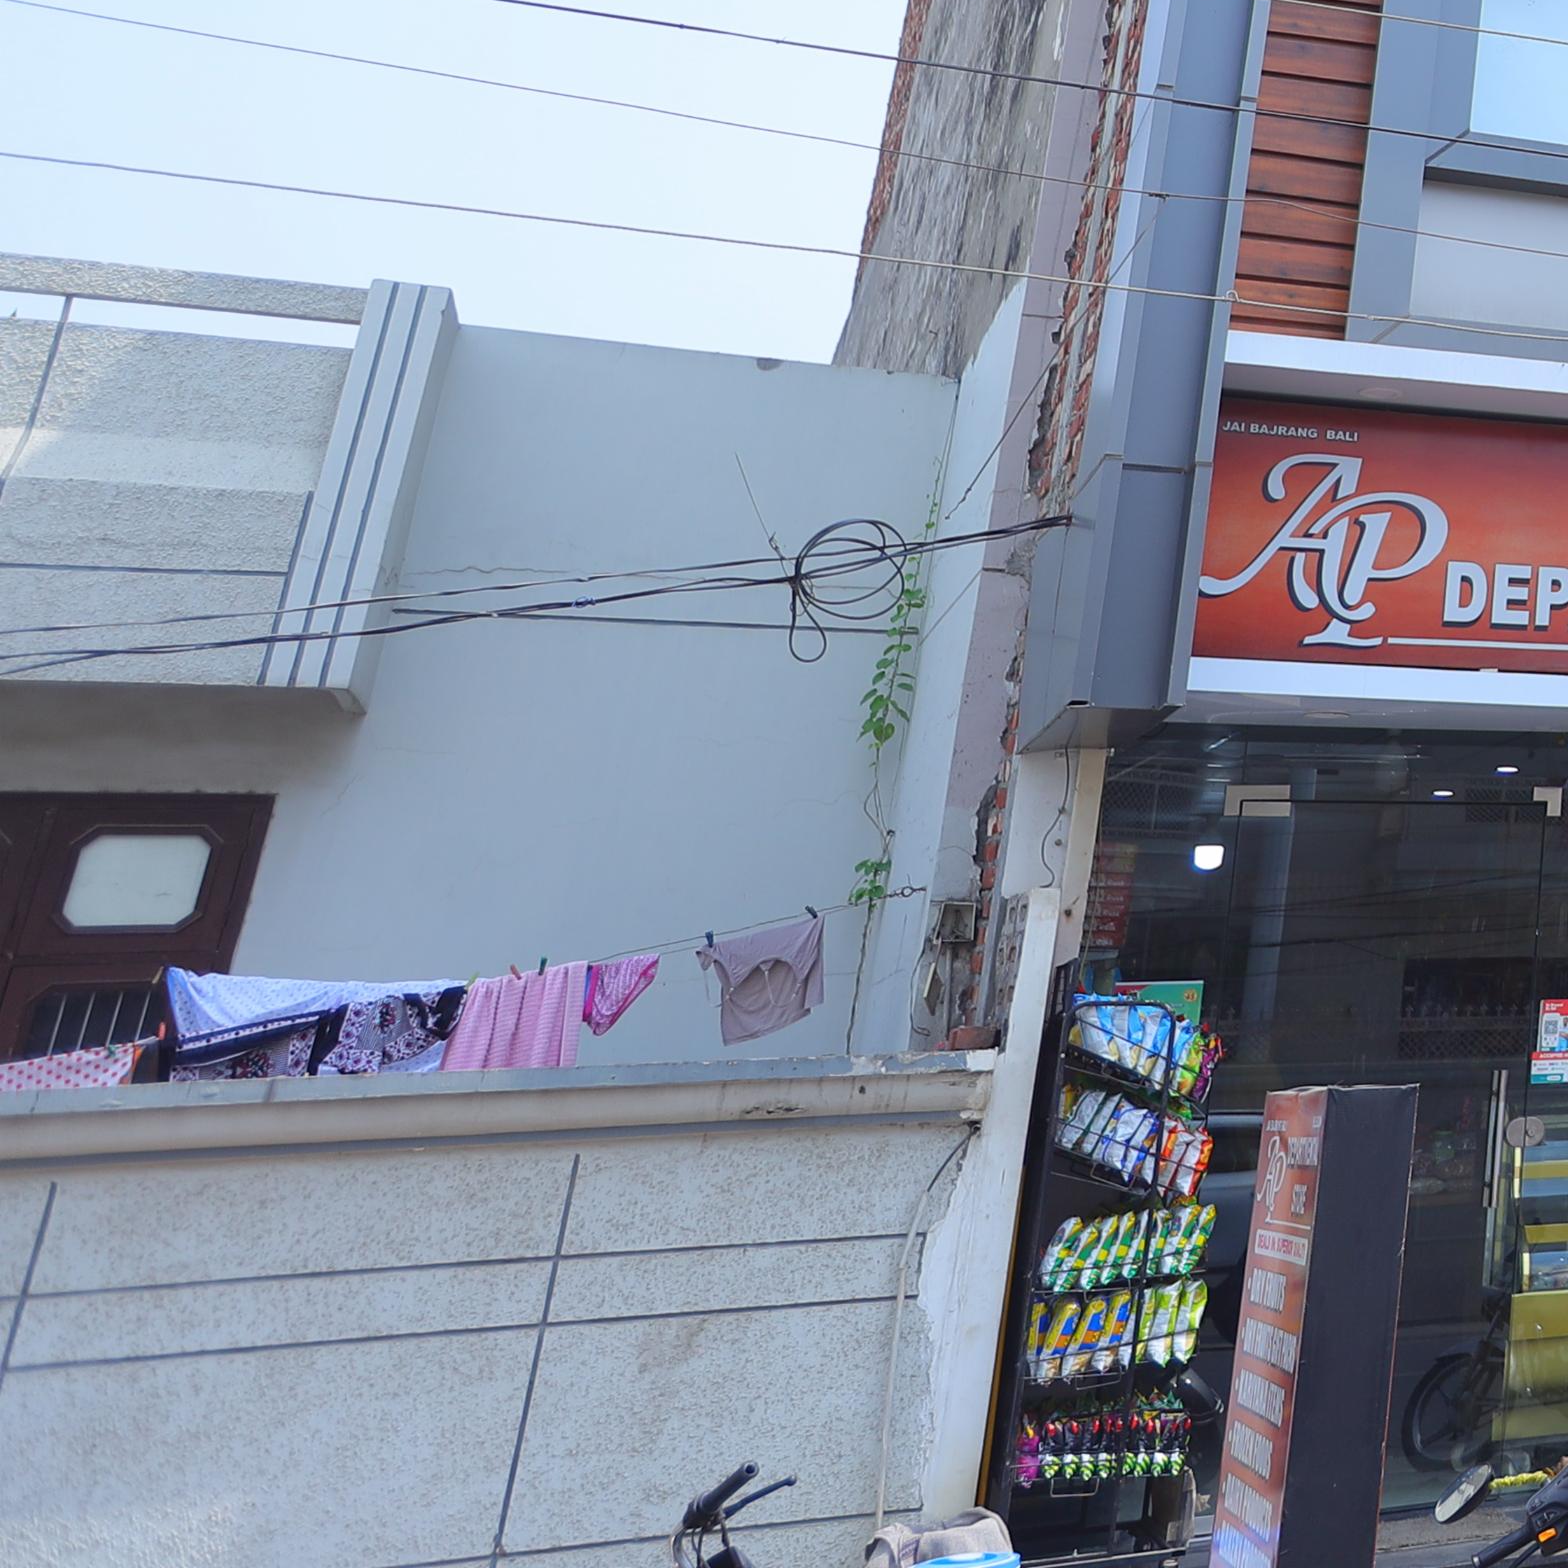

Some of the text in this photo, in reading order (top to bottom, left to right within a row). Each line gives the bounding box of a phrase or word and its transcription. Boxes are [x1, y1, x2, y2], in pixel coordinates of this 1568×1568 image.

[1222, 421, 1359, 443] JAI BAJRANG BALI
